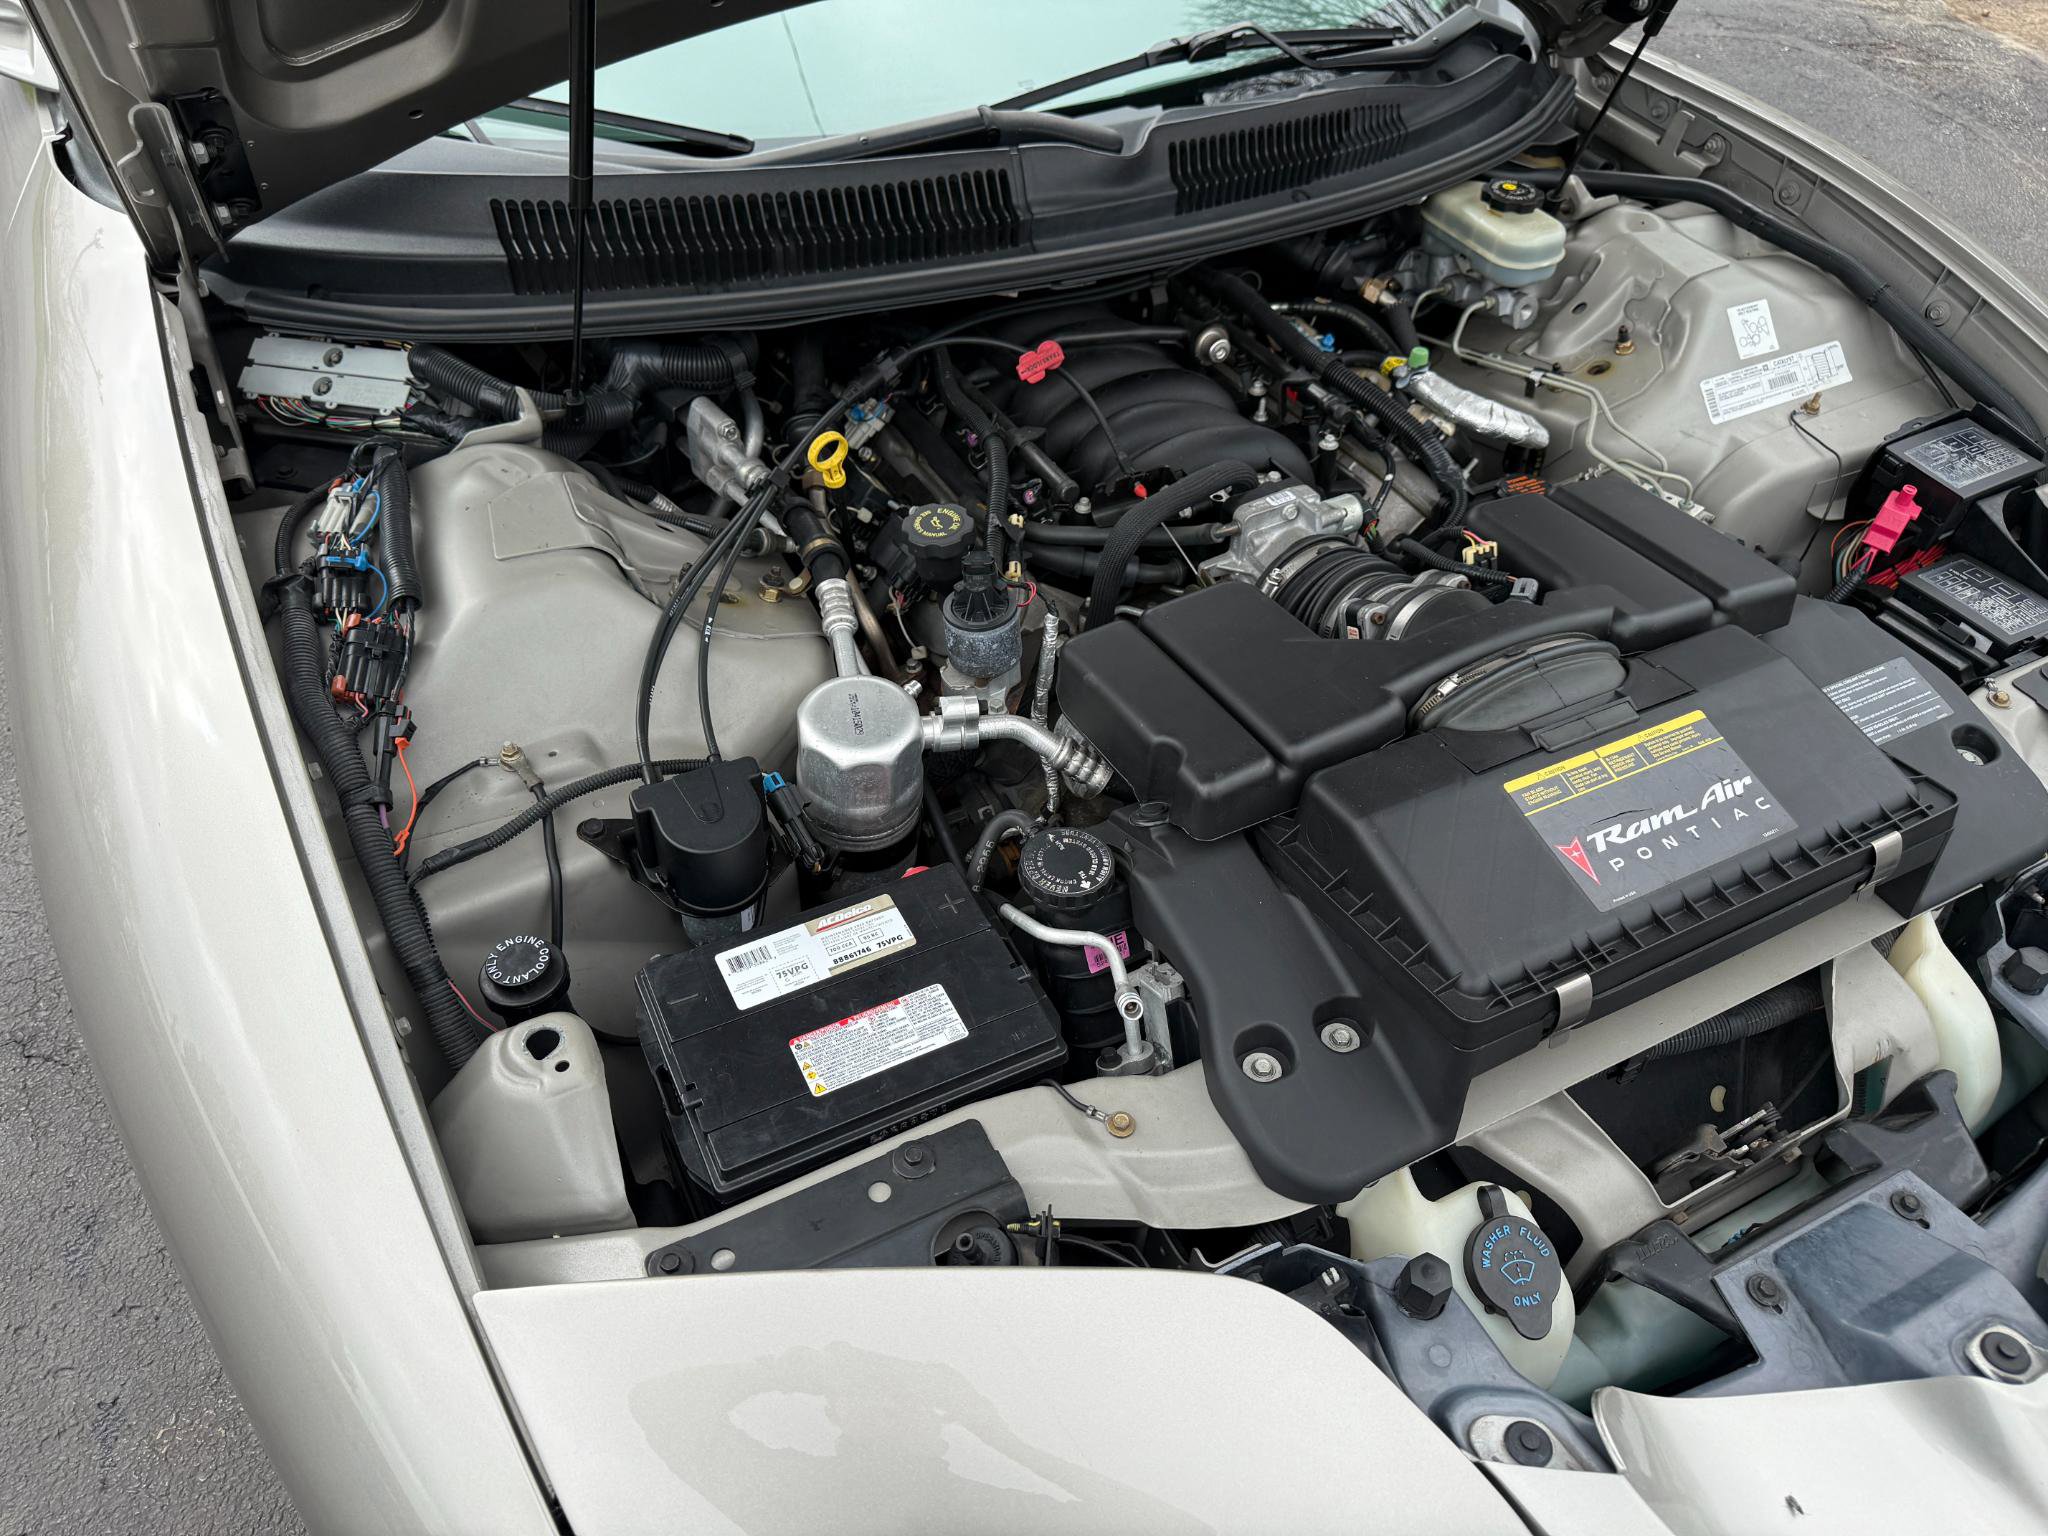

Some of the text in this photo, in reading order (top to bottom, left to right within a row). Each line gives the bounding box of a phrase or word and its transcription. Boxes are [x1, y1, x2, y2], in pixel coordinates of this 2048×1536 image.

[1645, 728, 1664, 738] CAUTION
[1544, 765, 1566, 776] CAUTION
[1586, 776, 1753, 853] Ram Air
[1609, 796, 1771, 872] PONTIAC
[1039, 878, 1069, 893] NEVER
[817, 904, 871, 928] ACDelco
[486, 935, 550, 984] ENGINE COOLANT ONLY
[833, 934, 904, 965] 88861746 75VPG
[776, 962, 809, 979] 75VPG
[1482, 1225, 1550, 1269] WASHER FLUID
[1514, 1291, 1542, 1307] ONLY
